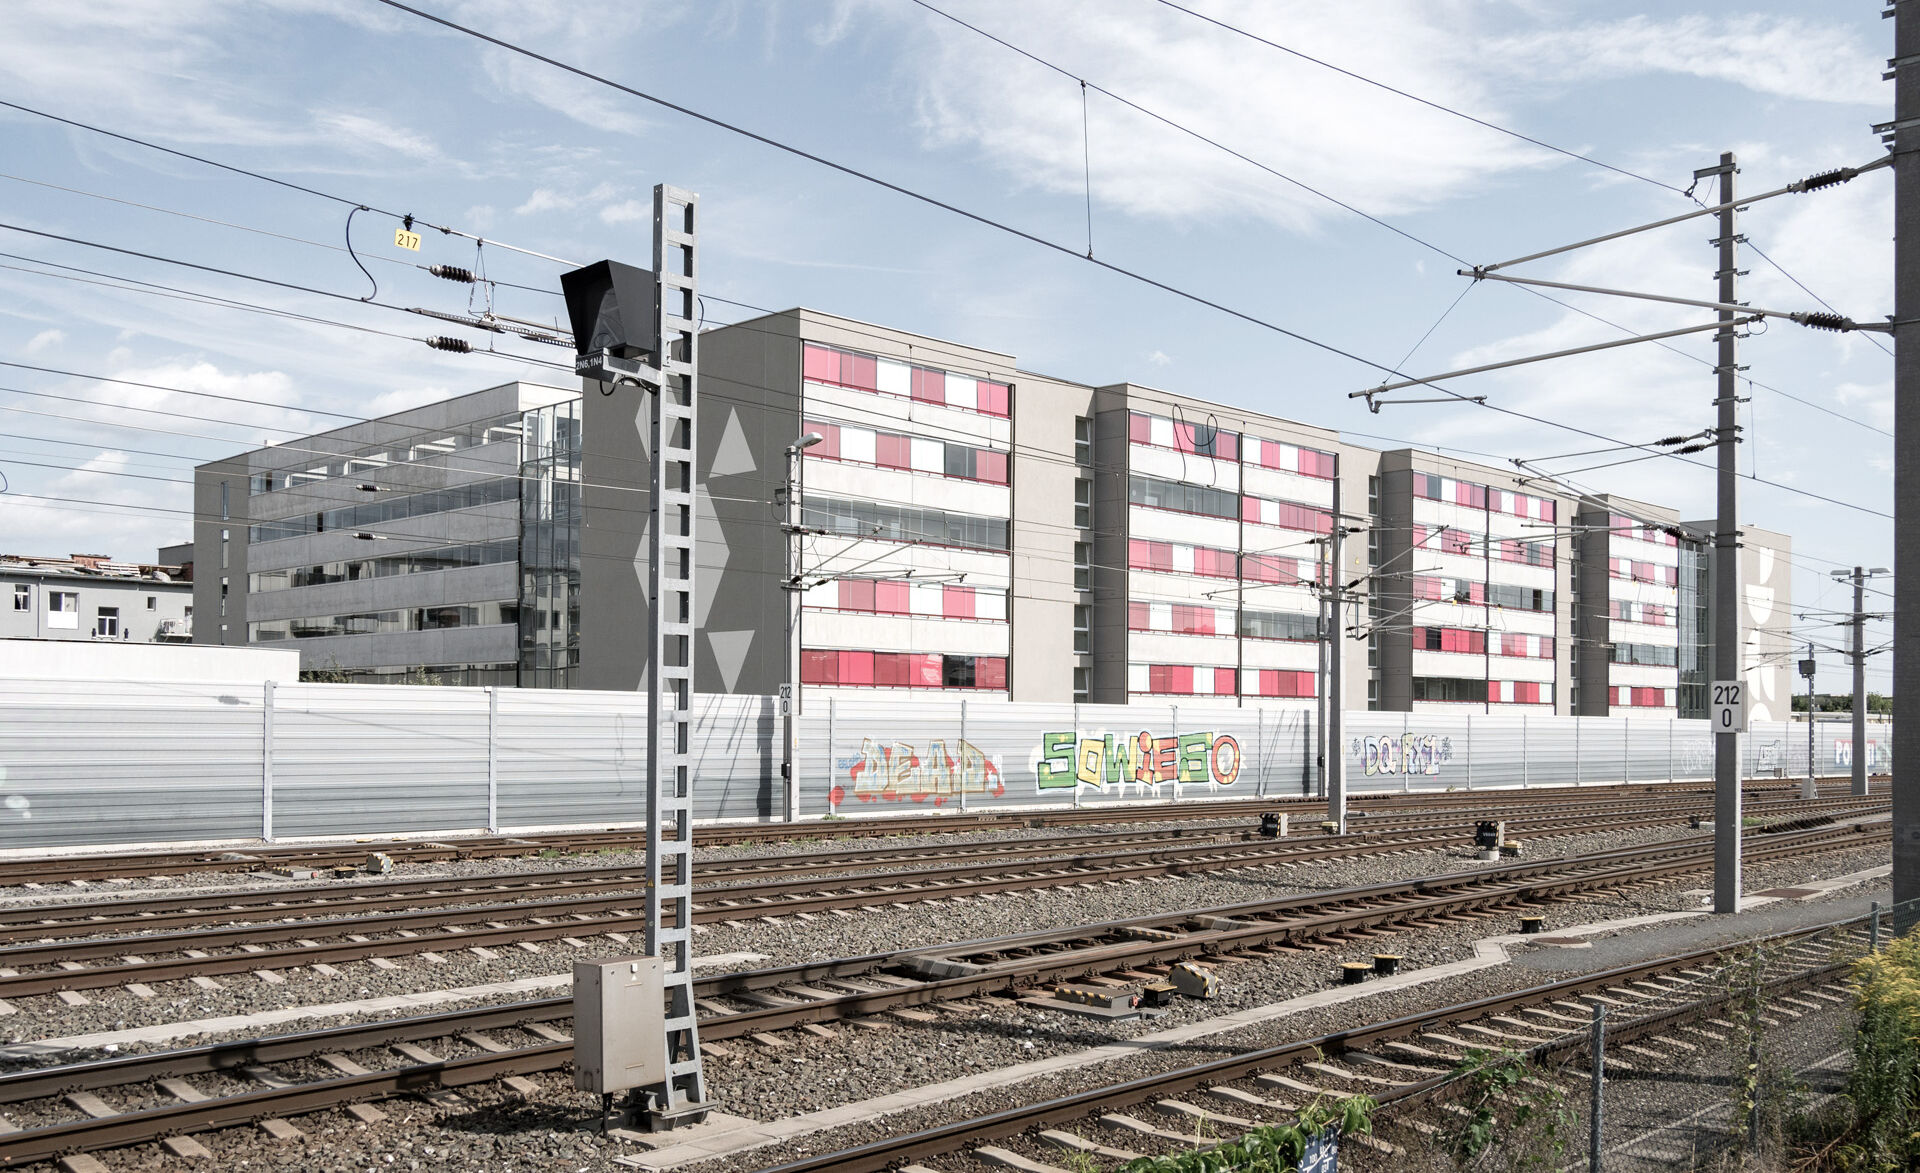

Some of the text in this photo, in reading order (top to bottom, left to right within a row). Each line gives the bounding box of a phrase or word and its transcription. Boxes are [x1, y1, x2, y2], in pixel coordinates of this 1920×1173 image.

[398, 233, 418, 249] 217
[780, 686, 792, 699] 212
[1714, 685, 1740, 705] 212
[783, 700, 788, 713] 0
[1722, 708, 1732, 728] 0
